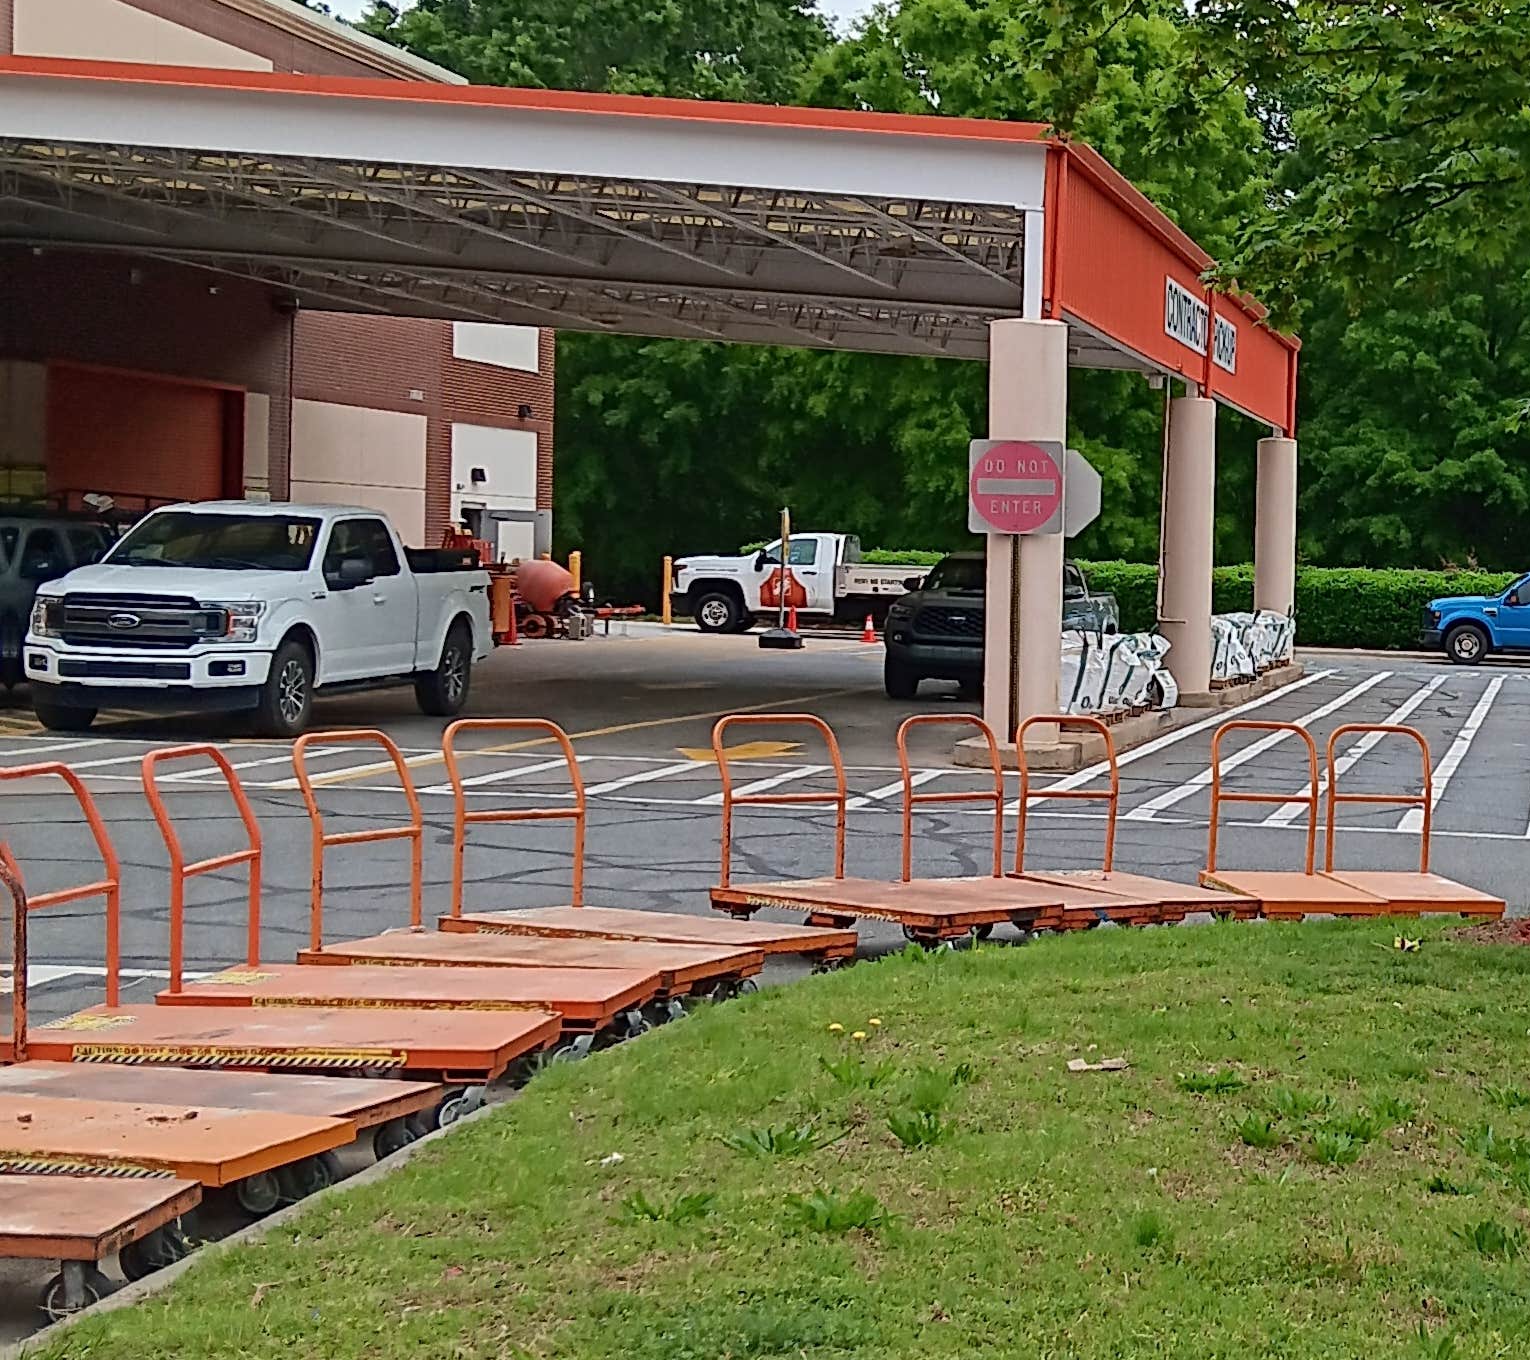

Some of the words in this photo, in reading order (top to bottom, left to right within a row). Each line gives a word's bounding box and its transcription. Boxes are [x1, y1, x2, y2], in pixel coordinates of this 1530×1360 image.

[1167, 283, 1209, 351] CONTRACTO
[984, 459, 1005, 473] DO
[1017, 460, 1049, 474] NOT
[990, 499, 1042, 514] ENTER
